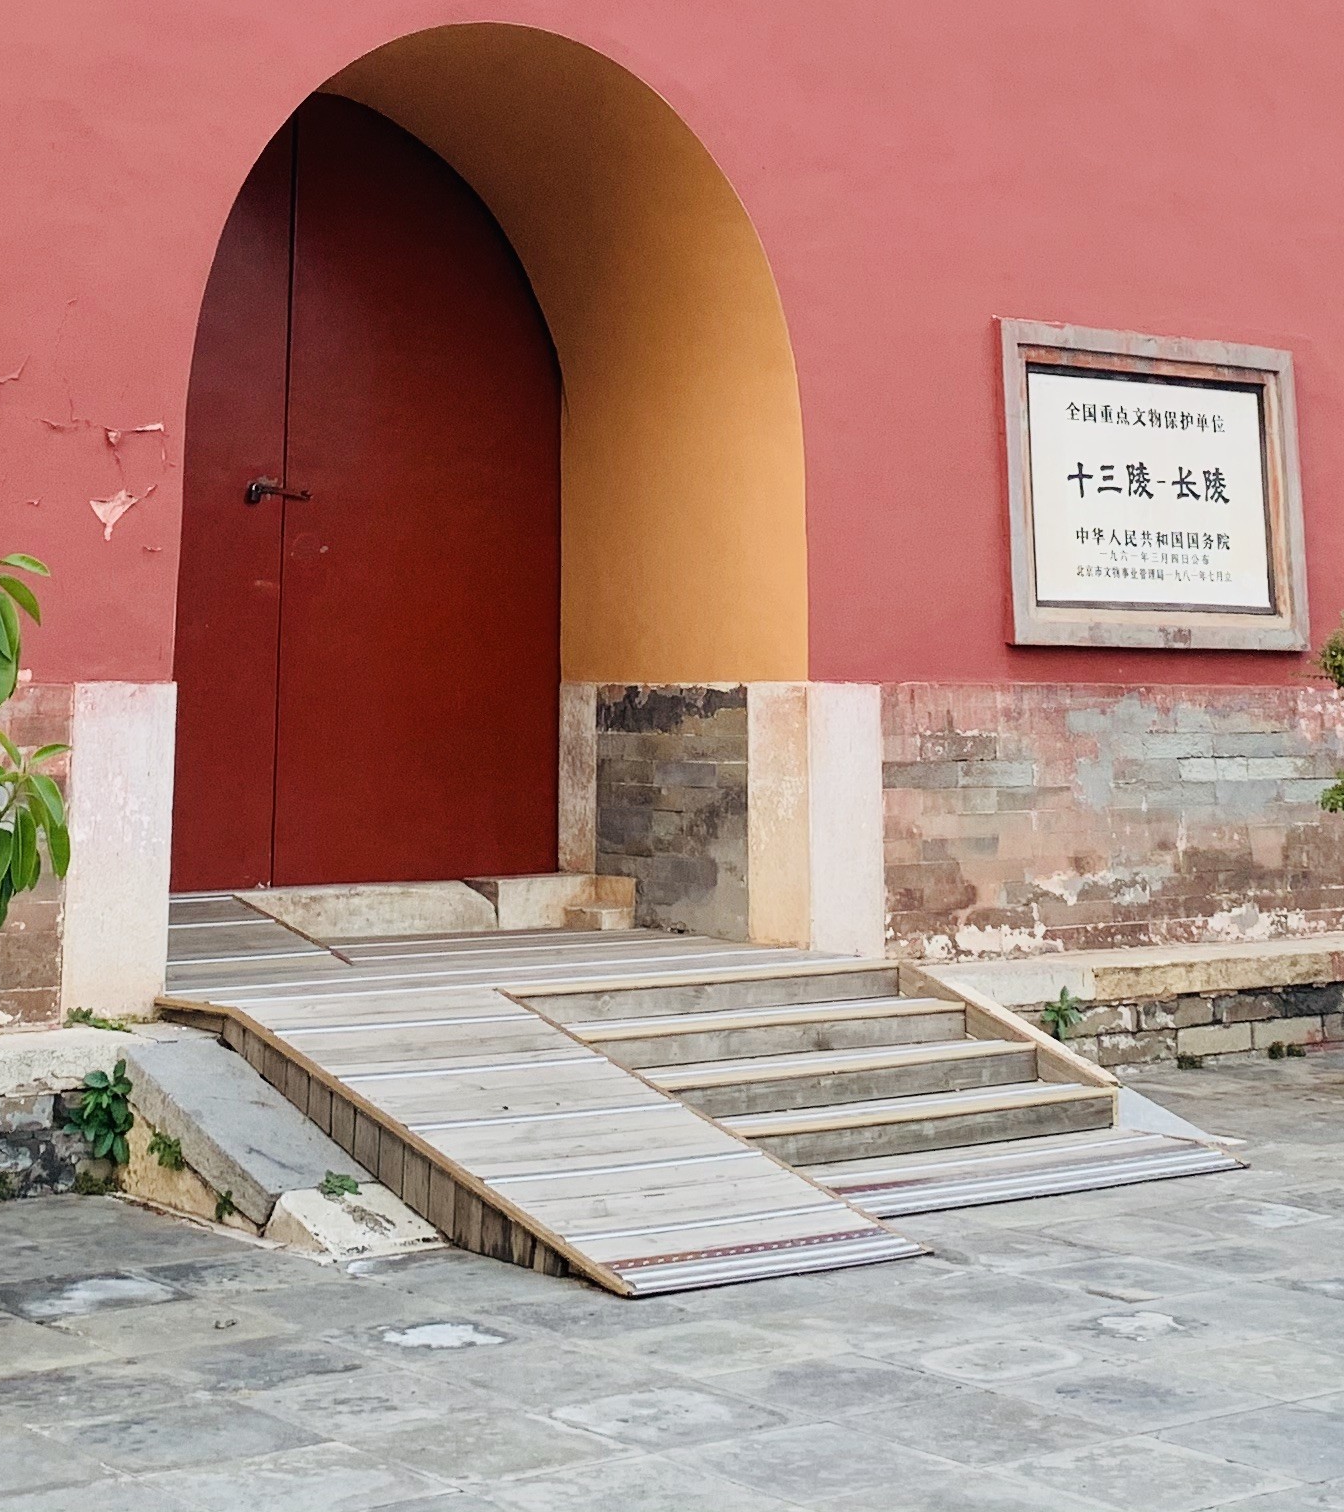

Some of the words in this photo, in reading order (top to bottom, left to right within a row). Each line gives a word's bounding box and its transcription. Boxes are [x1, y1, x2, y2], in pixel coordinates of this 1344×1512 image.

[1066, 402, 1225, 433] 全国重点文物保护单位
[1076, 527, 1230, 550] 中华人民共和国国务院
